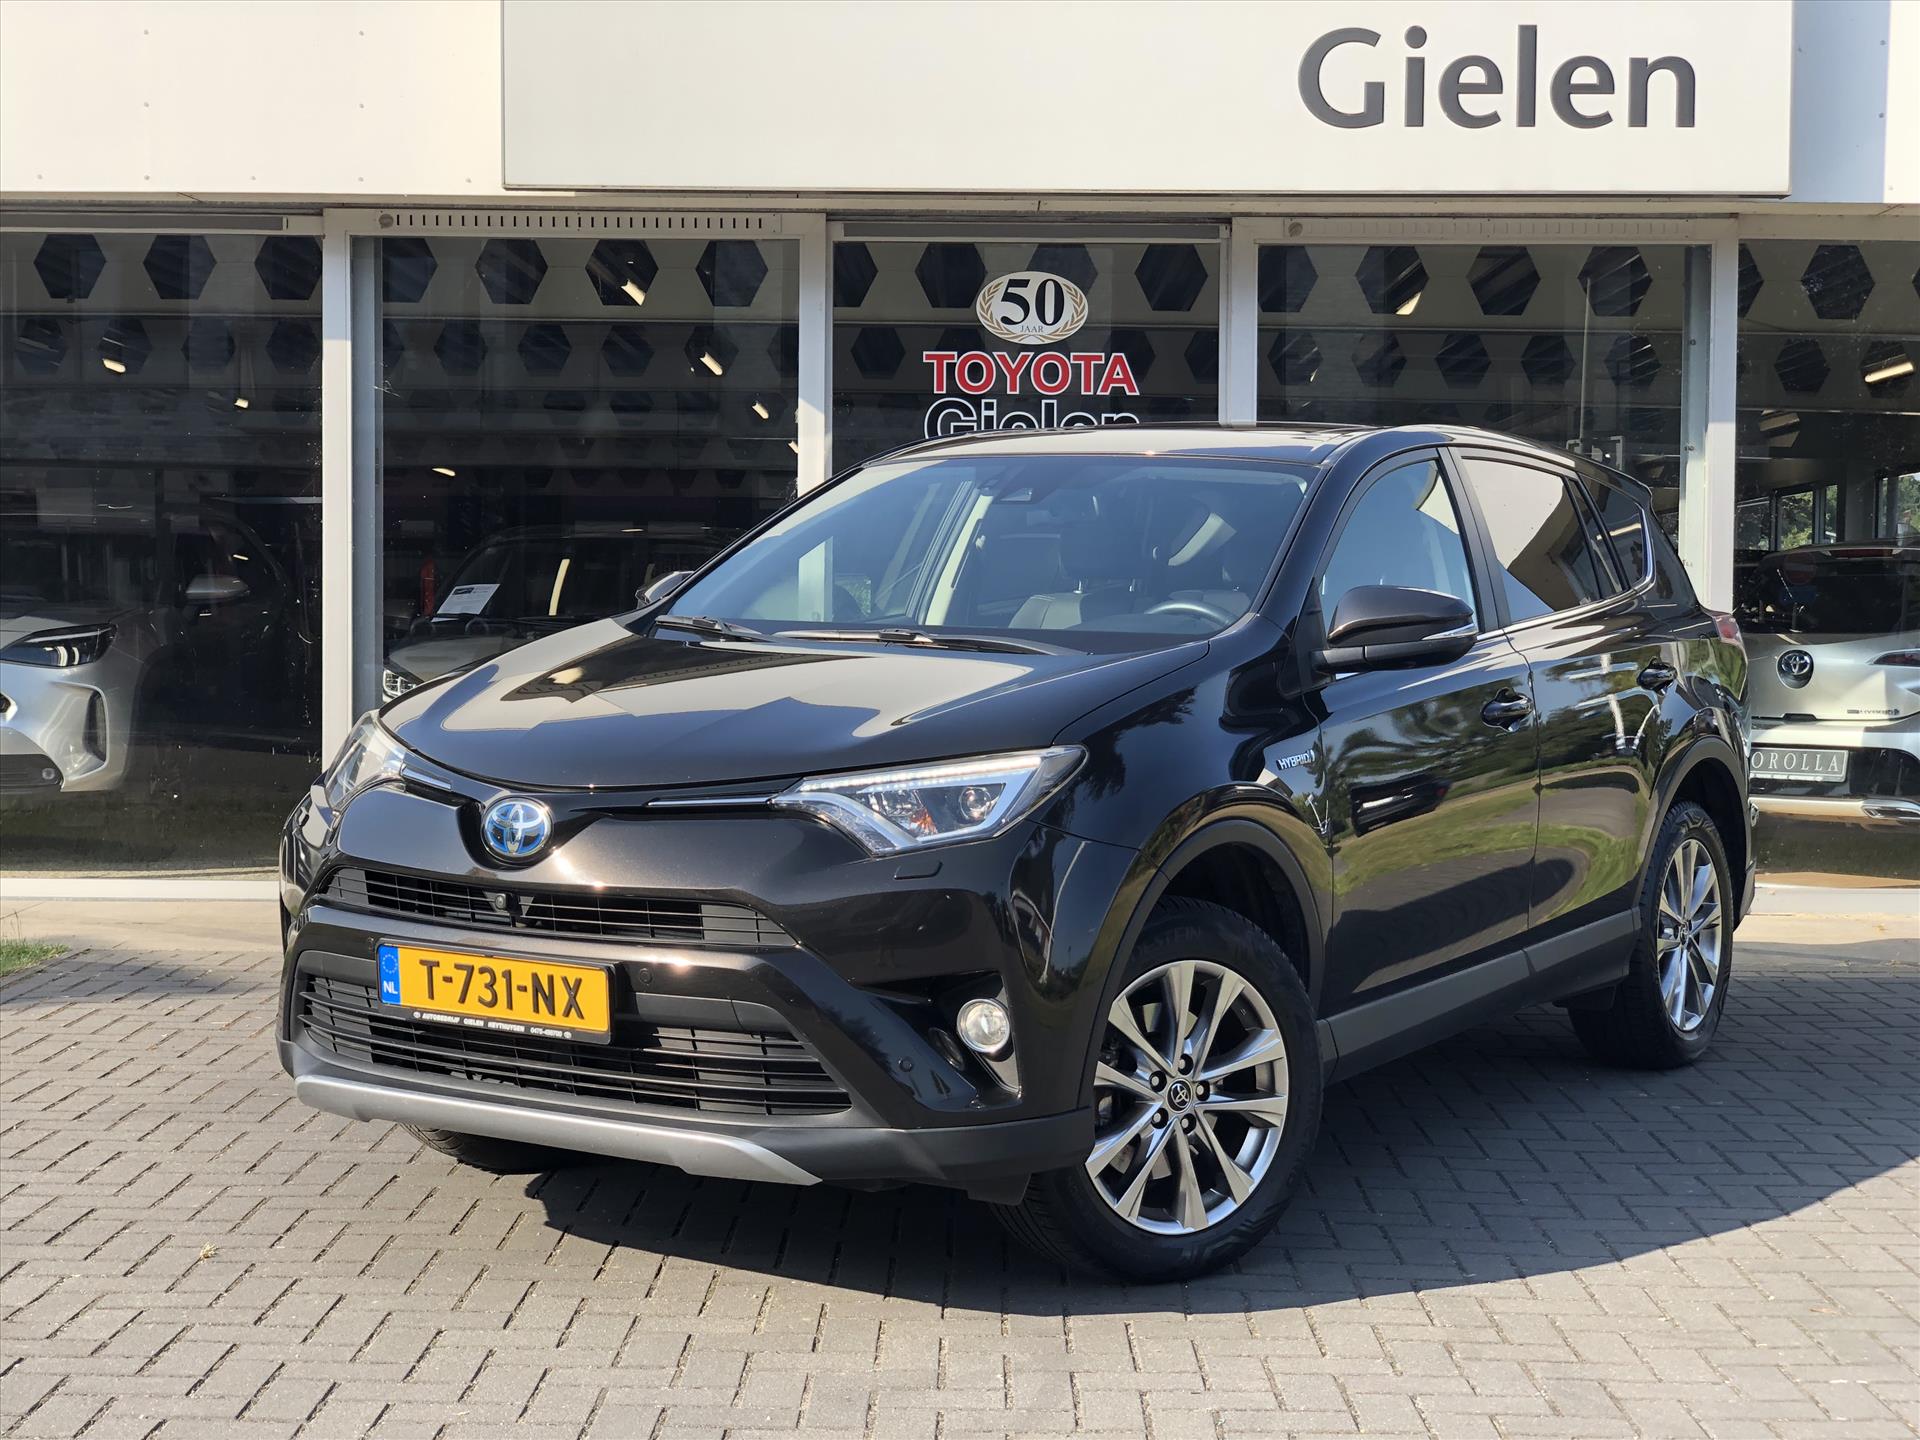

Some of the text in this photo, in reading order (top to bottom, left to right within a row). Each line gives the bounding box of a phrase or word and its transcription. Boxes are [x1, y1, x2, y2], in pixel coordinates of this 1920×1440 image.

[1298, 24, 1696, 129] Gielen
[1000, 278, 1065, 326] 50
[1020, 325, 1044, 333] JAAR
[923, 351, 1140, 395] TOYOTA
[924, 398, 1140, 438] Gil
[1278, 753, 1311, 769] HYBRID
[1751, 751, 1839, 772] OROLLA
[383, 980, 398, 995] NL
[419, 959, 585, 1020] T-731-NX
[463, 1017, 484, 1027] GIELEN
